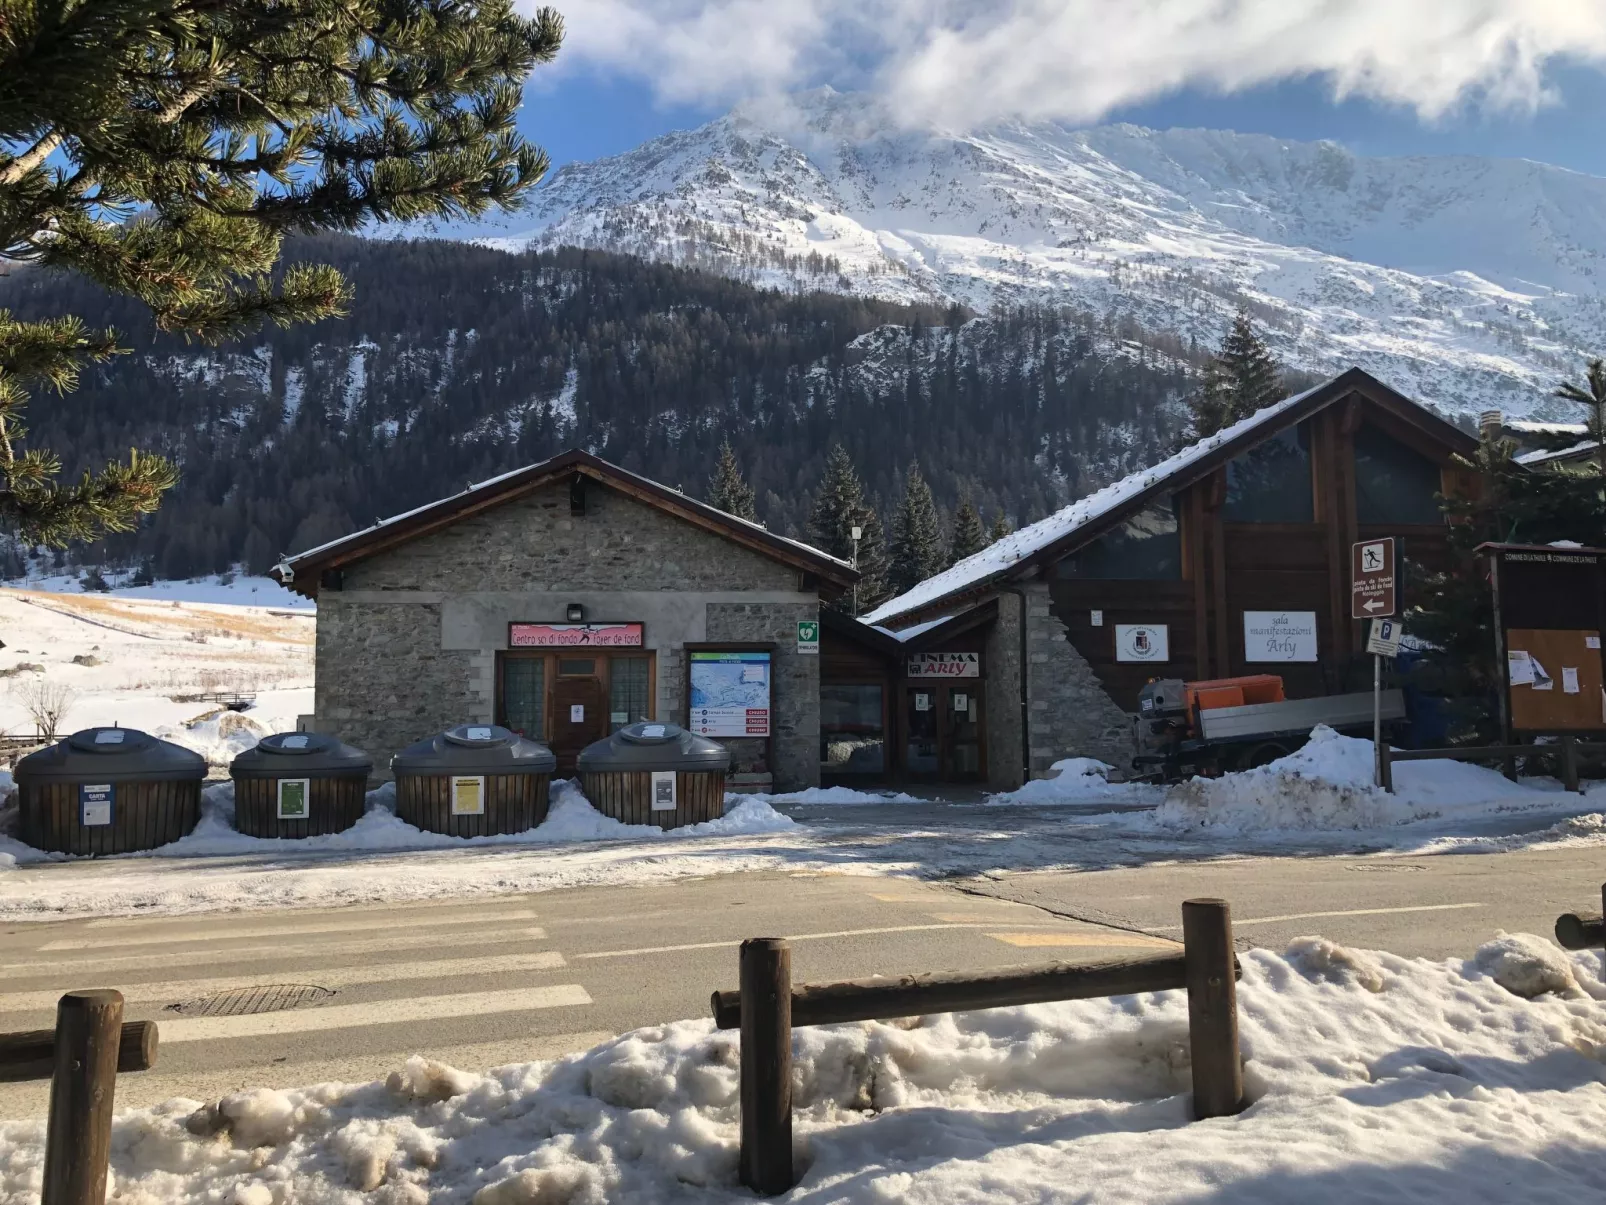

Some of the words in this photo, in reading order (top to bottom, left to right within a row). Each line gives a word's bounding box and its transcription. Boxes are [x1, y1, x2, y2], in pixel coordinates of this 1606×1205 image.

[1272, 614, 1288, 625] sala
[1250, 625, 1312, 640] manifestazioni
[1383, 625, 1390, 636] P
[512, 633, 536, 644] Centro
[538, 636, 547, 644] sci
[549, 633, 556, 644] di
[558, 634, 578, 644] fondo
[614, 634, 622, 644] de
[624, 633, 640, 644] fond
[1266, 636, 1296, 659] Arly
[924, 662, 967, 676] ARLY
